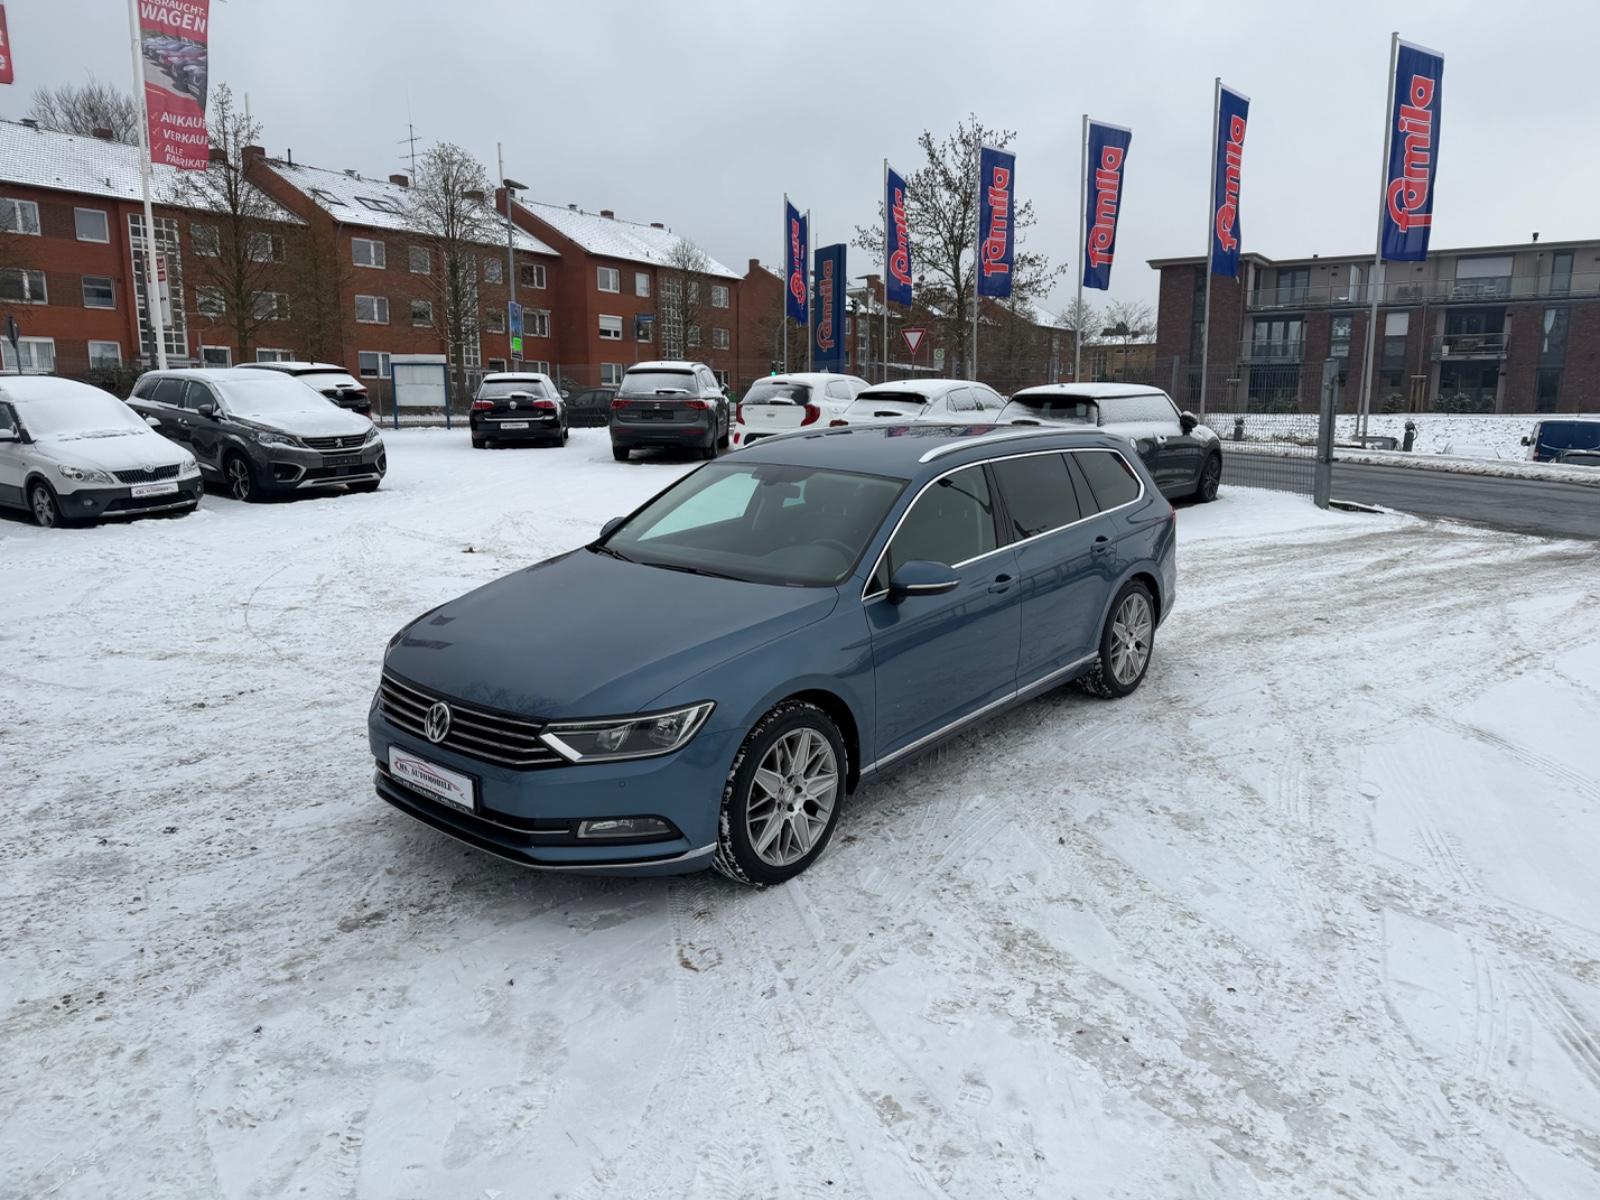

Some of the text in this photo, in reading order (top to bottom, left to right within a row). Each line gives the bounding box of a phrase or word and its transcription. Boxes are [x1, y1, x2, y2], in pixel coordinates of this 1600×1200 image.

[141, 2, 206, 33] WAGEN
[164, 144, 184, 157] ALLE
[1216, 114, 1246, 252] famila
[1387, 74, 1435, 233] famila
[981, 166, 1010, 277] famila
[1088, 145, 1124, 268] famila
[816, 260, 834, 352] famila
